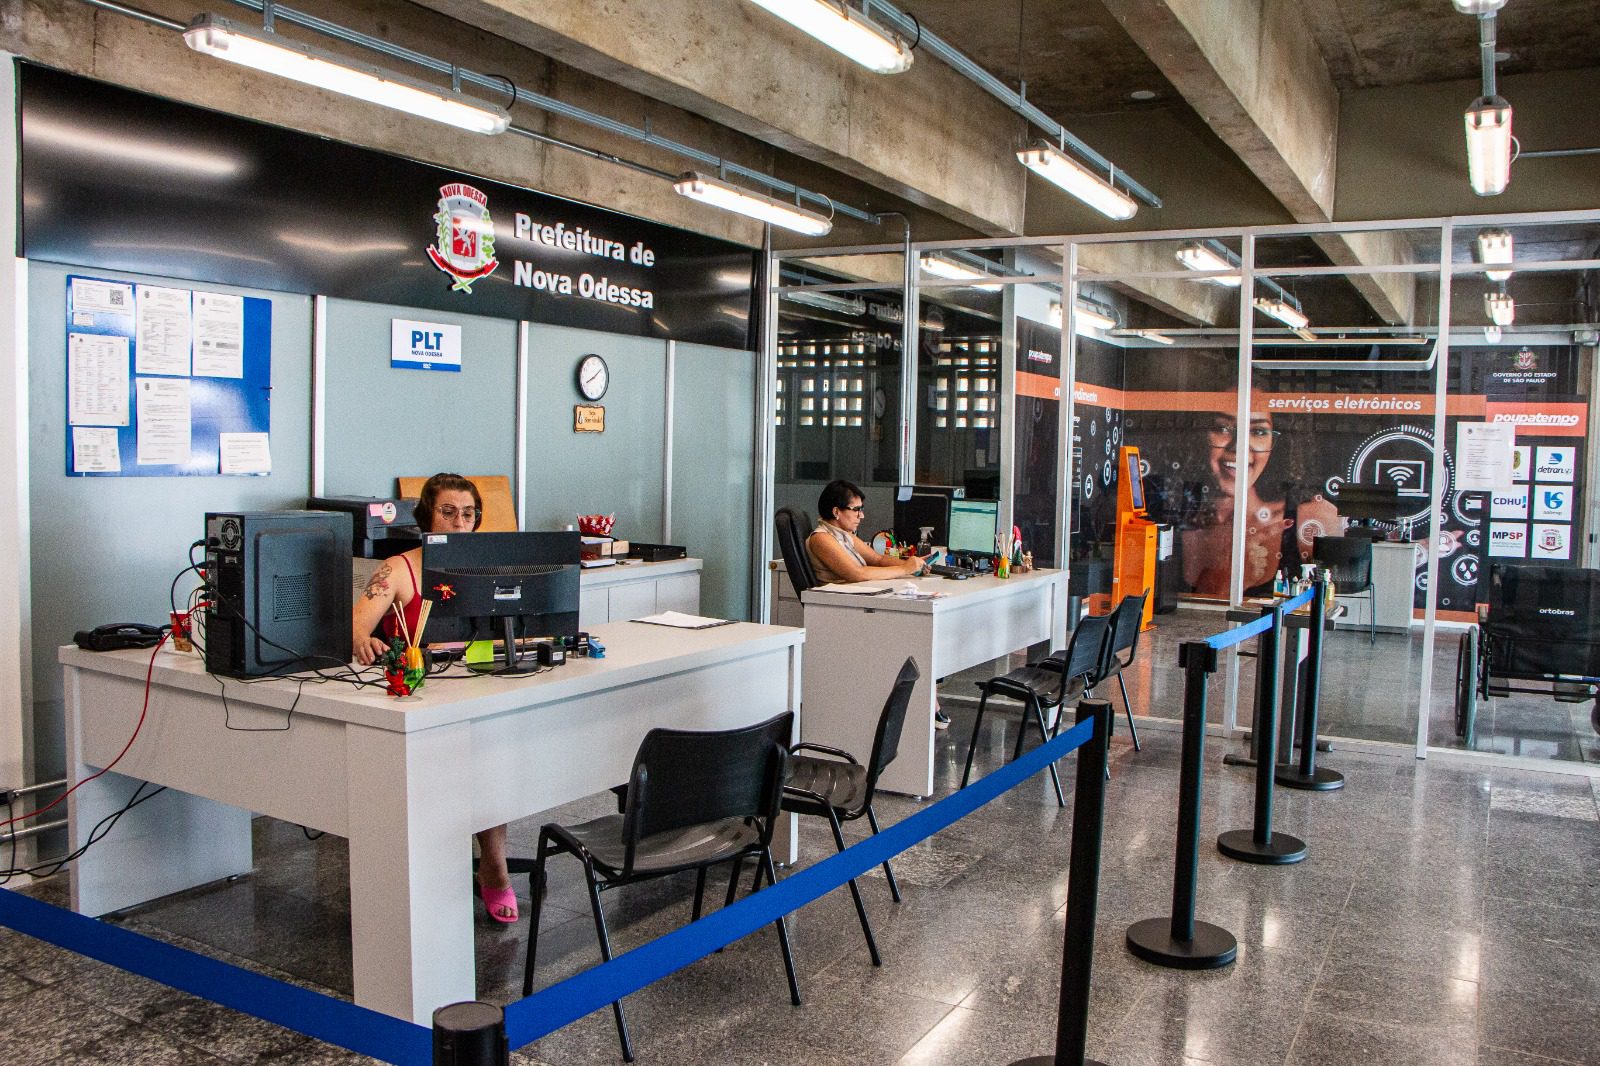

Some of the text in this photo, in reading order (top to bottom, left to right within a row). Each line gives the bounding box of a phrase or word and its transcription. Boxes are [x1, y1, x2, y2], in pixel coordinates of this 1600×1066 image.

[442, 186, 487, 207] NOVA ODESSA
[514, 213, 655, 267] Prefeitura de
[514, 260, 572, 294] Nova
[577, 273, 654, 309] Odessa
[411, 330, 443, 351] PLT
[1268, 396, 1422, 411] serviços eletrônicos
[1493, 413, 1580, 426] poupatempo
[1492, 531, 1524, 540] MPSP
[1539, 608, 1575, 616] ortobras
